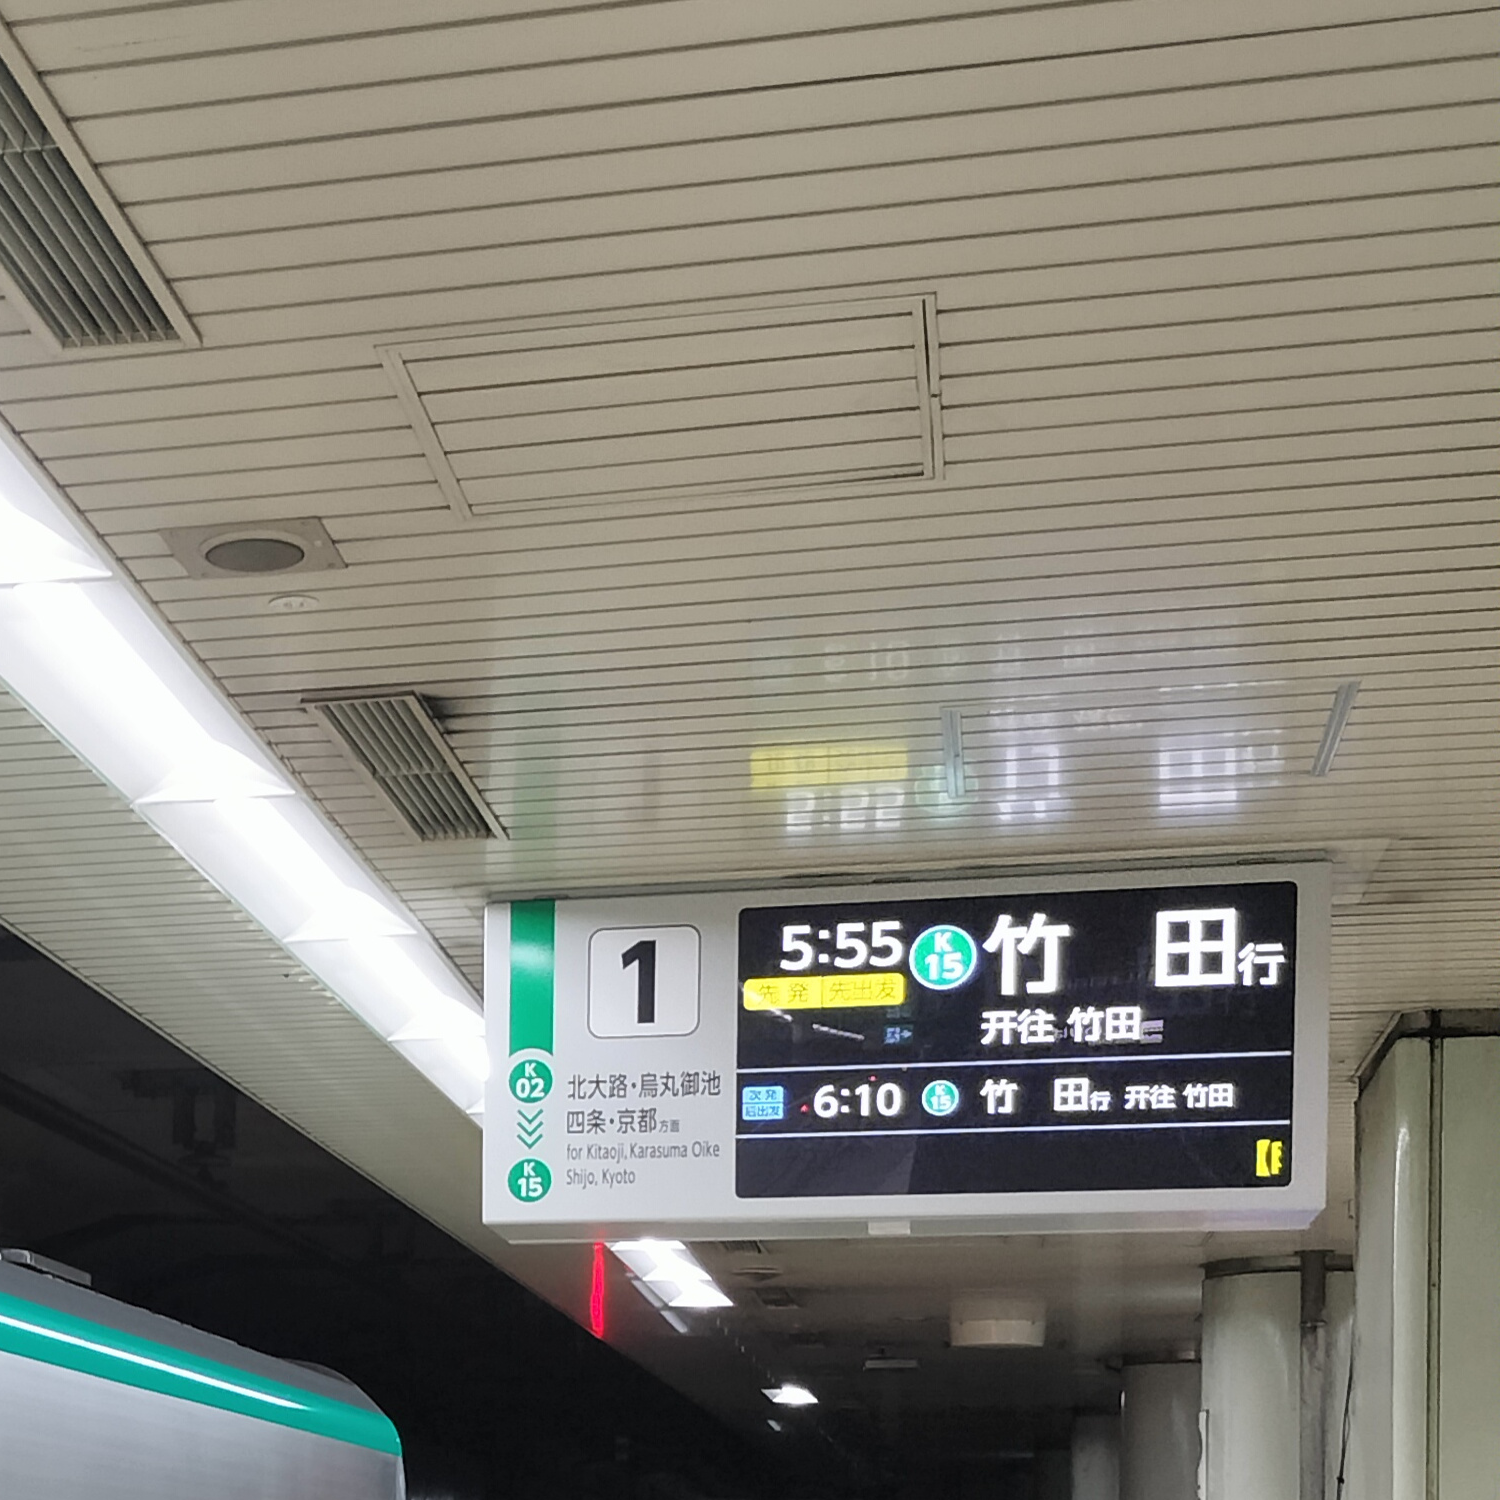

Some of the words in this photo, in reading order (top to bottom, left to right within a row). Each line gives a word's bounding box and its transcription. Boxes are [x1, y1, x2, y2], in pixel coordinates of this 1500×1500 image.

[779, 920, 904, 971] 5:55
[934, 932, 952, 952] K
[925, 952, 964, 981] 15
[620, 939, 657, 1025] 1
[980, 1007, 1057, 1045] 开往
[1067, 1005, 1142, 1043] 竹田
[525, 1062, 536, 1077] K
[516, 1078, 545, 1099] 02
[1182, 1082, 1235, 1109] 竹田
[813, 1082, 902, 1119] 6:10
[931, 1096, 950, 1110] 15
[567, 1143, 583, 1160] for
[586, 1143, 628, 1164] Kitaoji,
[630, 1142, 688, 1159] Karasuma
[691, 1140, 721, 1158] Oike
[524, 1162, 536, 1176] K
[566, 1168, 598, 1190] Shijo,
[602, 1168, 636, 1188] Kyoto
[518, 1178, 543, 1197] 15
